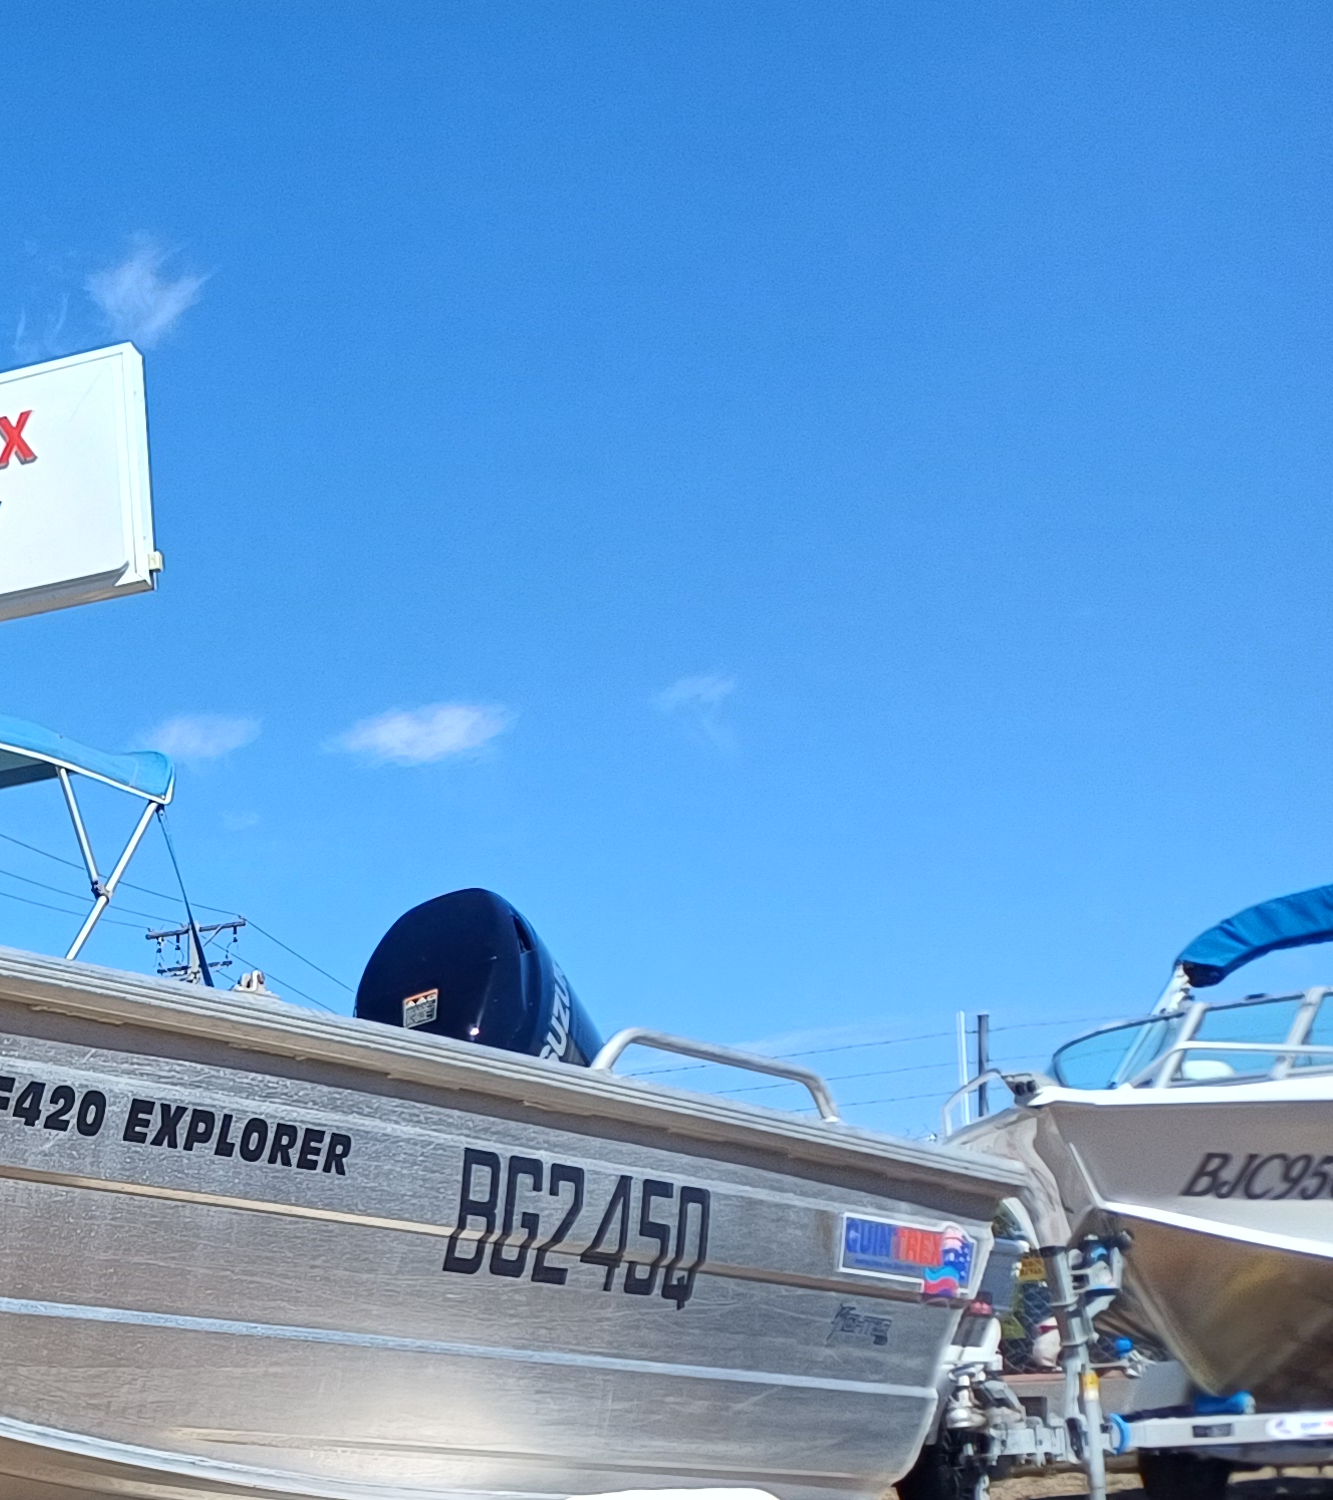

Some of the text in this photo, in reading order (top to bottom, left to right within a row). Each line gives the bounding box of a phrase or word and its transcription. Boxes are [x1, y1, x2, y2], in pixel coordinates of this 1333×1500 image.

[122, 1098, 352, 1176] EXPLORER
[1179, 1152, 1333, 1200] BJC95
[442, 1147, 711, 1311] BG245Q
